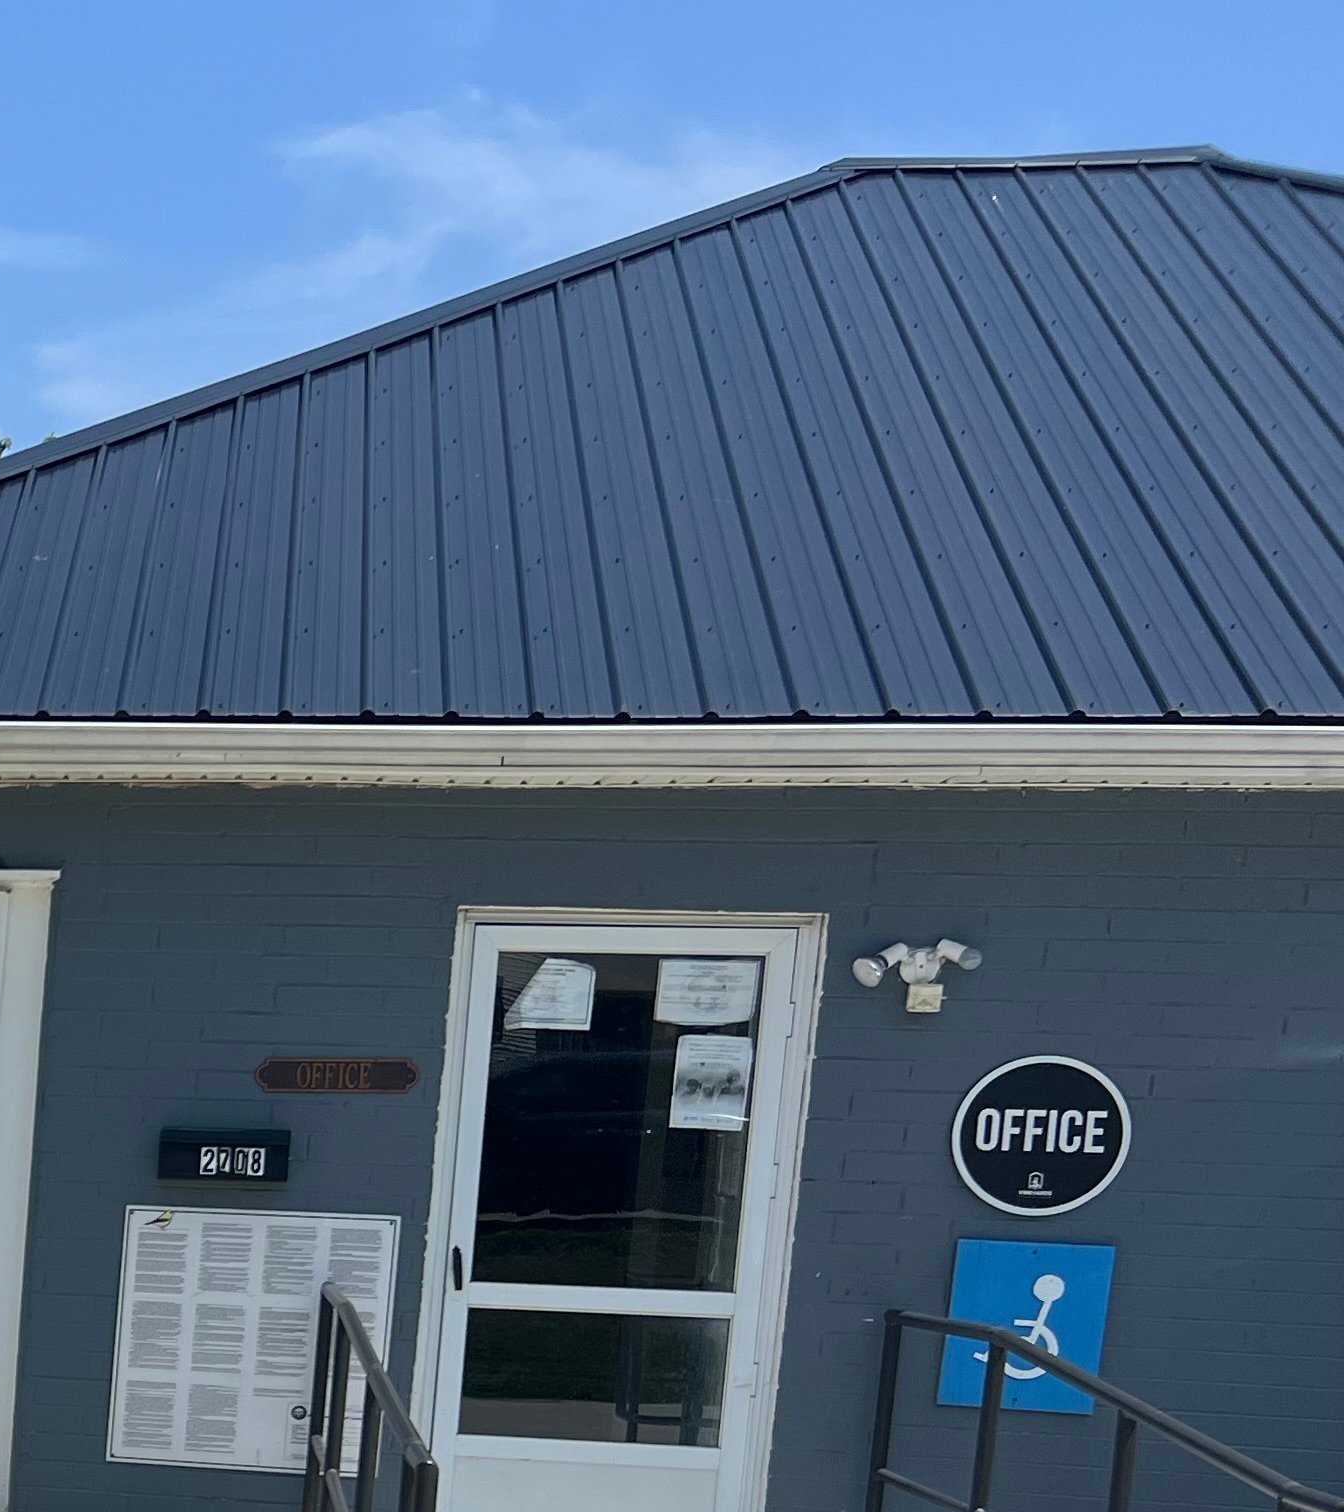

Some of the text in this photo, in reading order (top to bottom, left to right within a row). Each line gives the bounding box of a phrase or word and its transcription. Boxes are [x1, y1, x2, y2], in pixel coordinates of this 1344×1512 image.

[296, 1062, 372, 1089] OFFICE
[975, 1107, 1109, 1154] OFFICE
[200, 1148, 265, 1175] 2708
